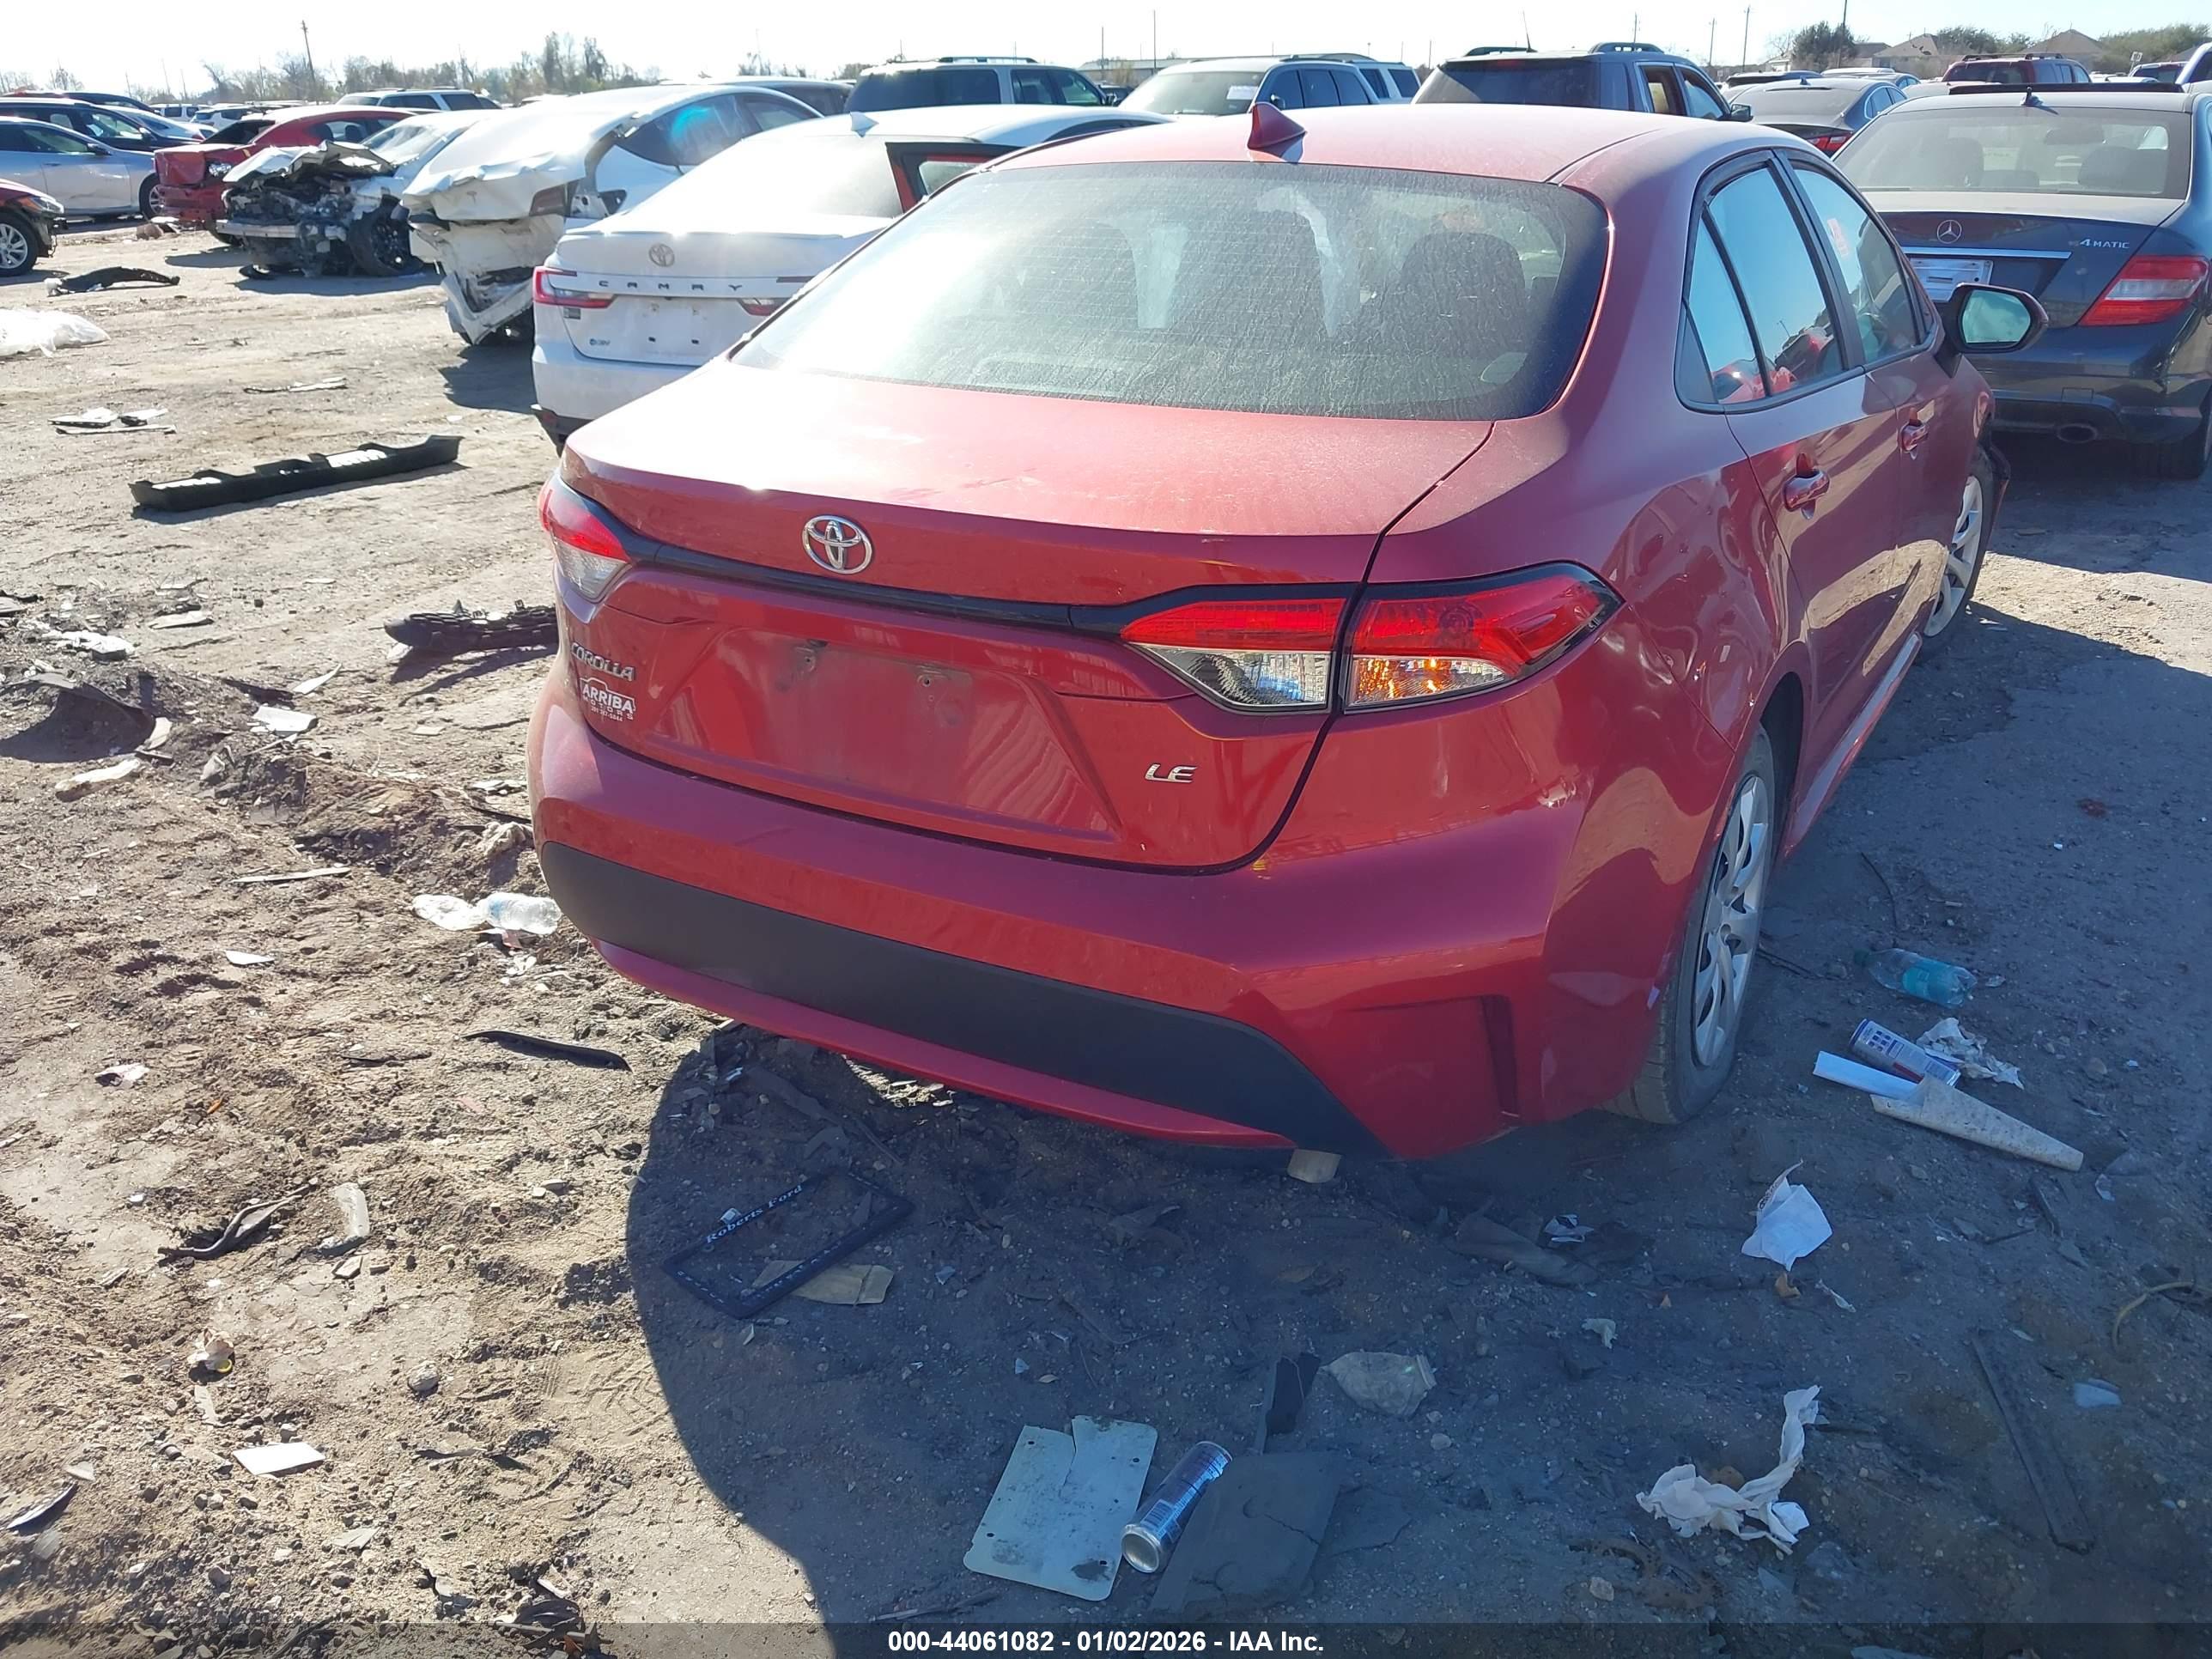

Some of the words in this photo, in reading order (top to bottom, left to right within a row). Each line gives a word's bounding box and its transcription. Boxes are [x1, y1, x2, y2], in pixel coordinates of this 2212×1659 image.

[599, 279, 743, 292] CAMRY
[570, 641, 635, 682] COROLLA
[582, 684, 634, 714] ARRIBA
[583, 694, 634, 720] MOTORS
[1144, 763, 1198, 784] LE
[706, 1207, 764, 1244] Roberts
[768, 1184, 803, 1208] Ford
